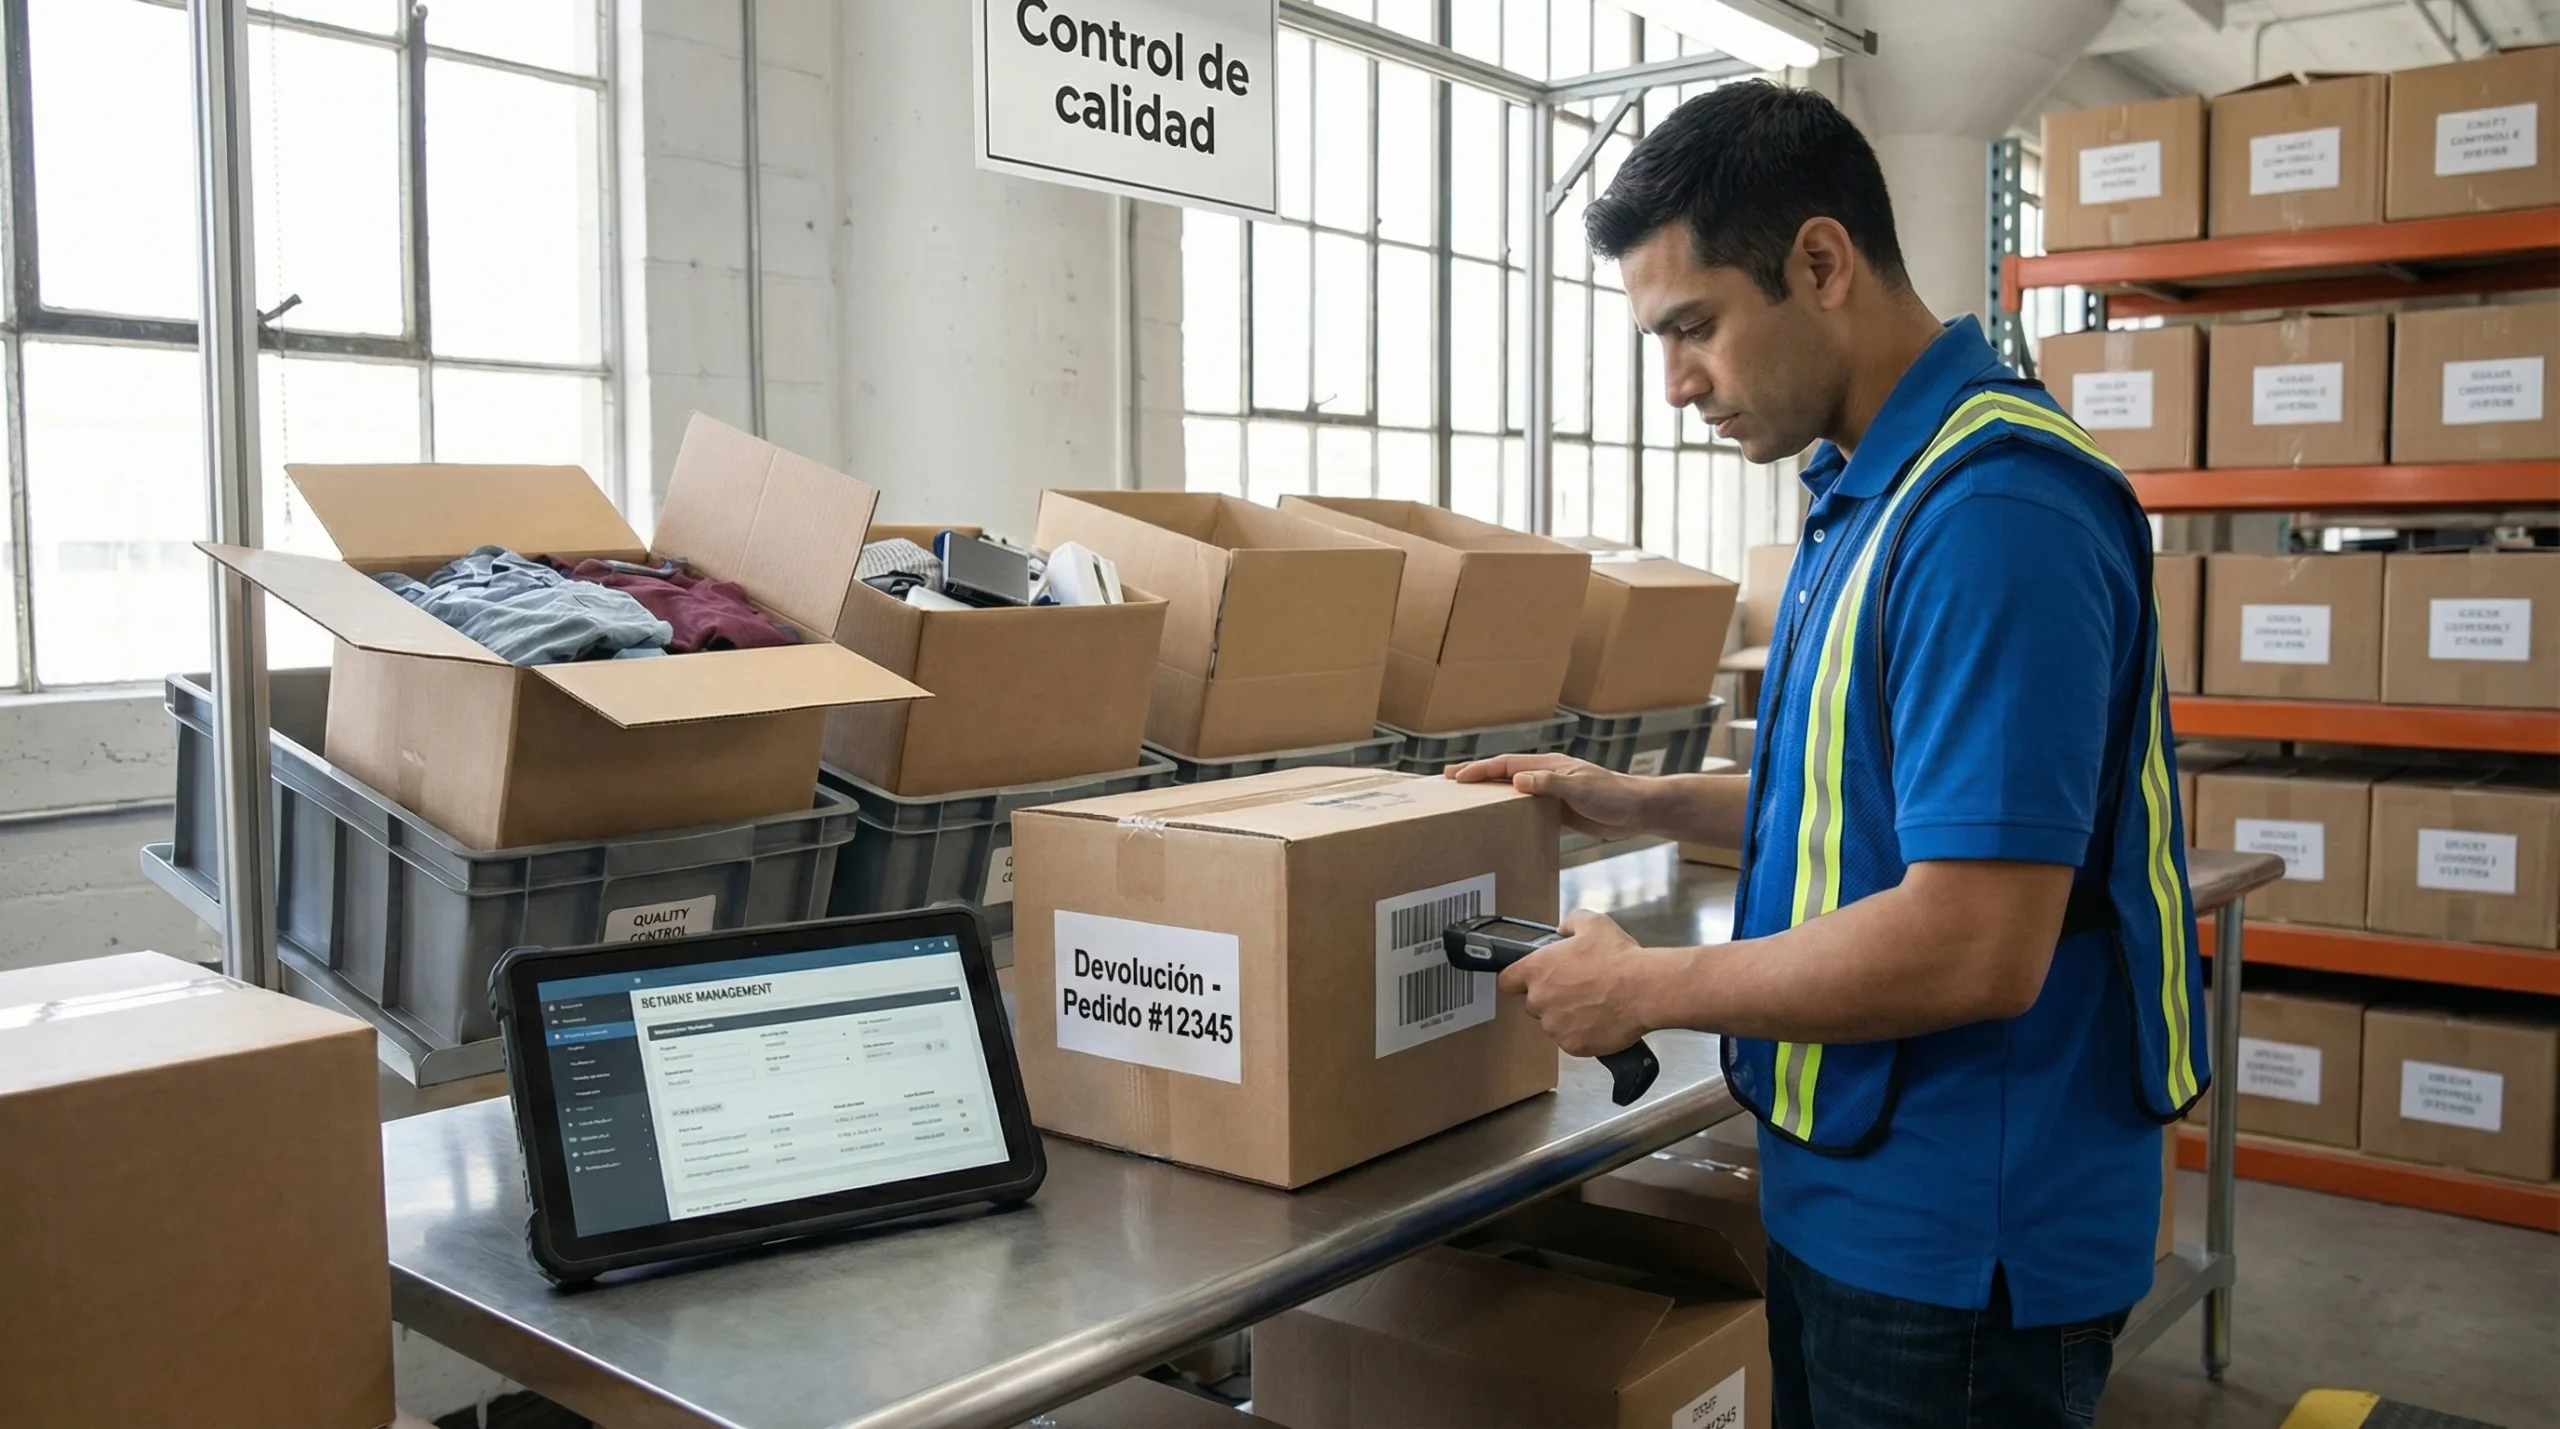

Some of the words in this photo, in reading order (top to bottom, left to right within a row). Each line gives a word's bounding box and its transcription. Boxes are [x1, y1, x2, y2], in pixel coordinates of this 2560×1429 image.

[1017, 0, 1184, 81] Control
[1198, 43, 1249, 96] de
[1055, 84, 1215, 154] calidad
[633, 907, 690, 927] QUALITY
[695, 982, 772, 1002] MANAGEMENT
[1074, 948, 1204, 996] Devolución
[1063, 988, 1142, 1028] Pedido
[1148, 1002, 1234, 1045] #12345
